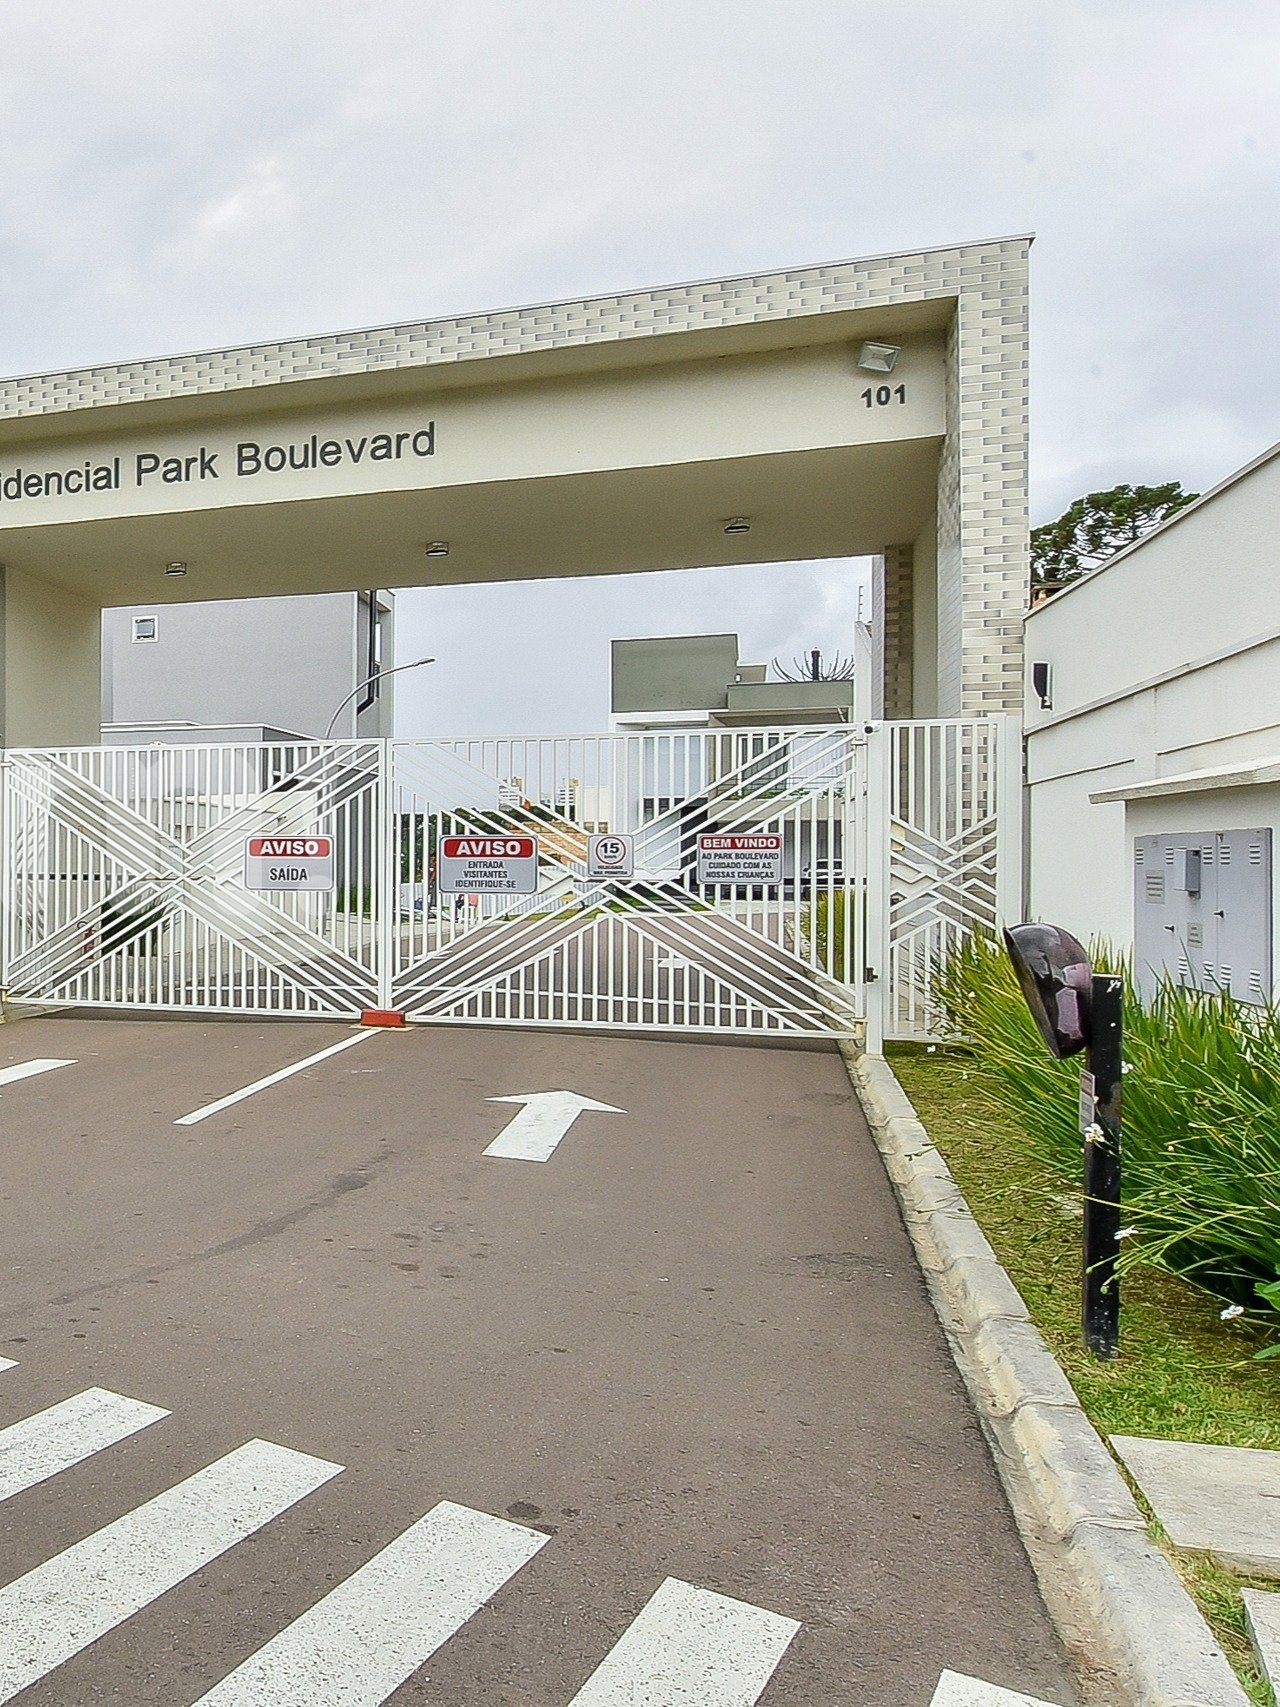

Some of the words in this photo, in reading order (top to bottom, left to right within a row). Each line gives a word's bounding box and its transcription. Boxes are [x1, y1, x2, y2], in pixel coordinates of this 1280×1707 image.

[860, 384, 906, 408] 101
[136, 447, 220, 486] Park
[237, 421, 436, 477] Boulevard
[259, 840, 319, 855] AVISO
[456, 840, 521, 856] AVISO
[600, 842, 620, 854] 15
[703, 838, 731, 848] BEM
[735, 838, 777, 848] VINDO
[468, 860, 504, 869] ENTRADA
[269, 865, 308, 881] SAÍDA
[463, 870, 508, 879] VISITANTES
[705, 871, 736, 879] NOSSAS
[737, 871, 775, 880] CRIANÇAS
[455, 880, 517, 889] IDENTIFIQUE-SE
